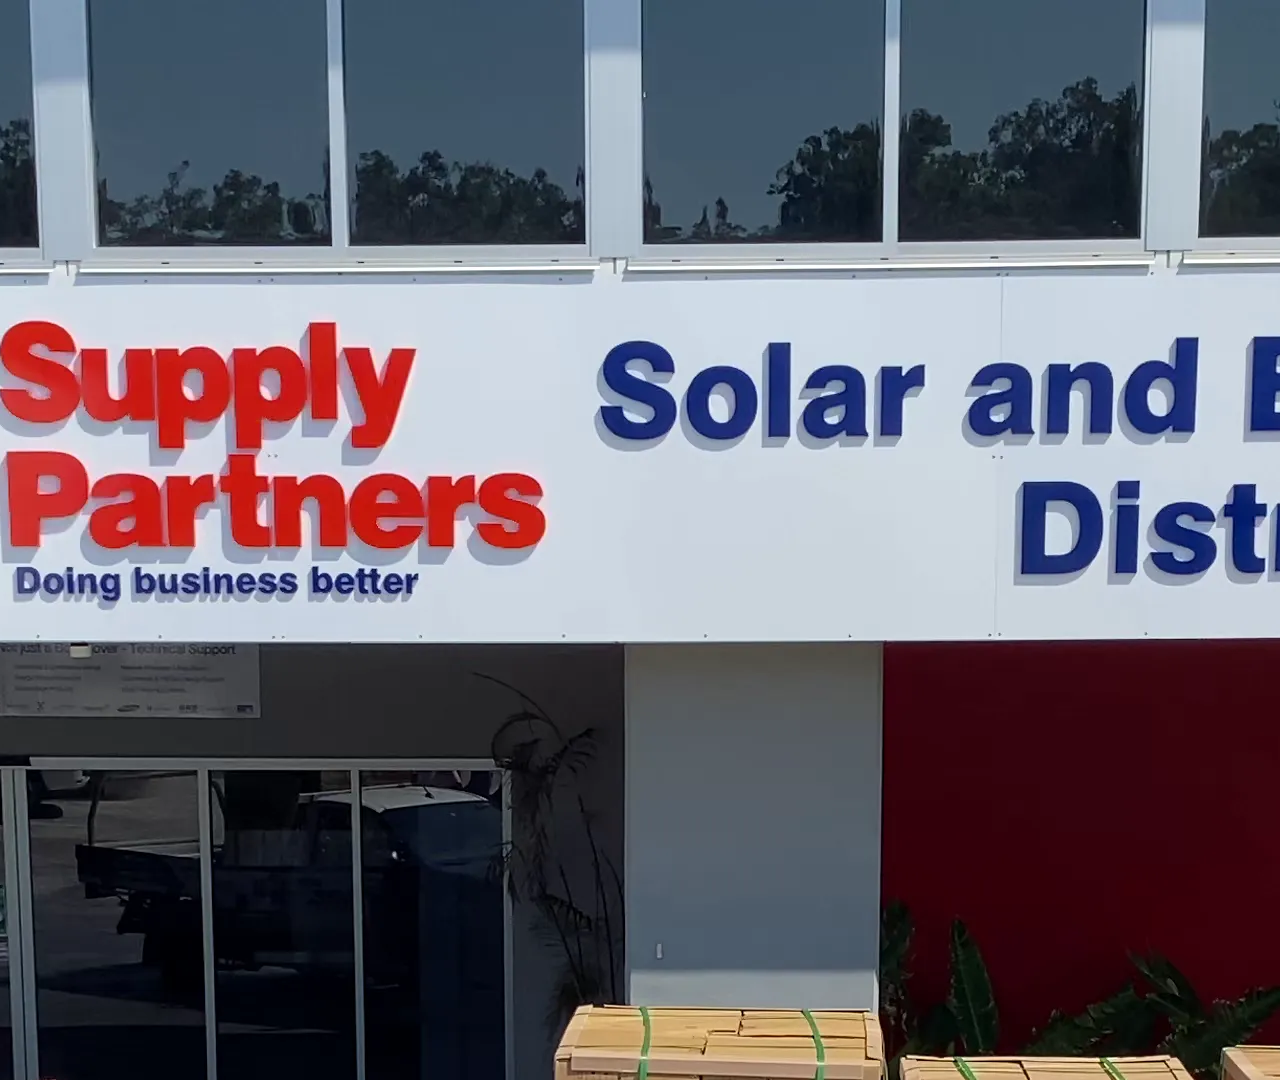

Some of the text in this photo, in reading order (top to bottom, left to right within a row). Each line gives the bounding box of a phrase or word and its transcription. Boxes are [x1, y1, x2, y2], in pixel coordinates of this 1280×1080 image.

[0, 320, 416, 449] Supply
[600, 340, 925, 440] Solar
[968, 337, 1199, 435] and
[6, 450, 546, 548] Partners
[16, 567, 418, 600] Doing business better
[188, 642, 236, 655] Support
